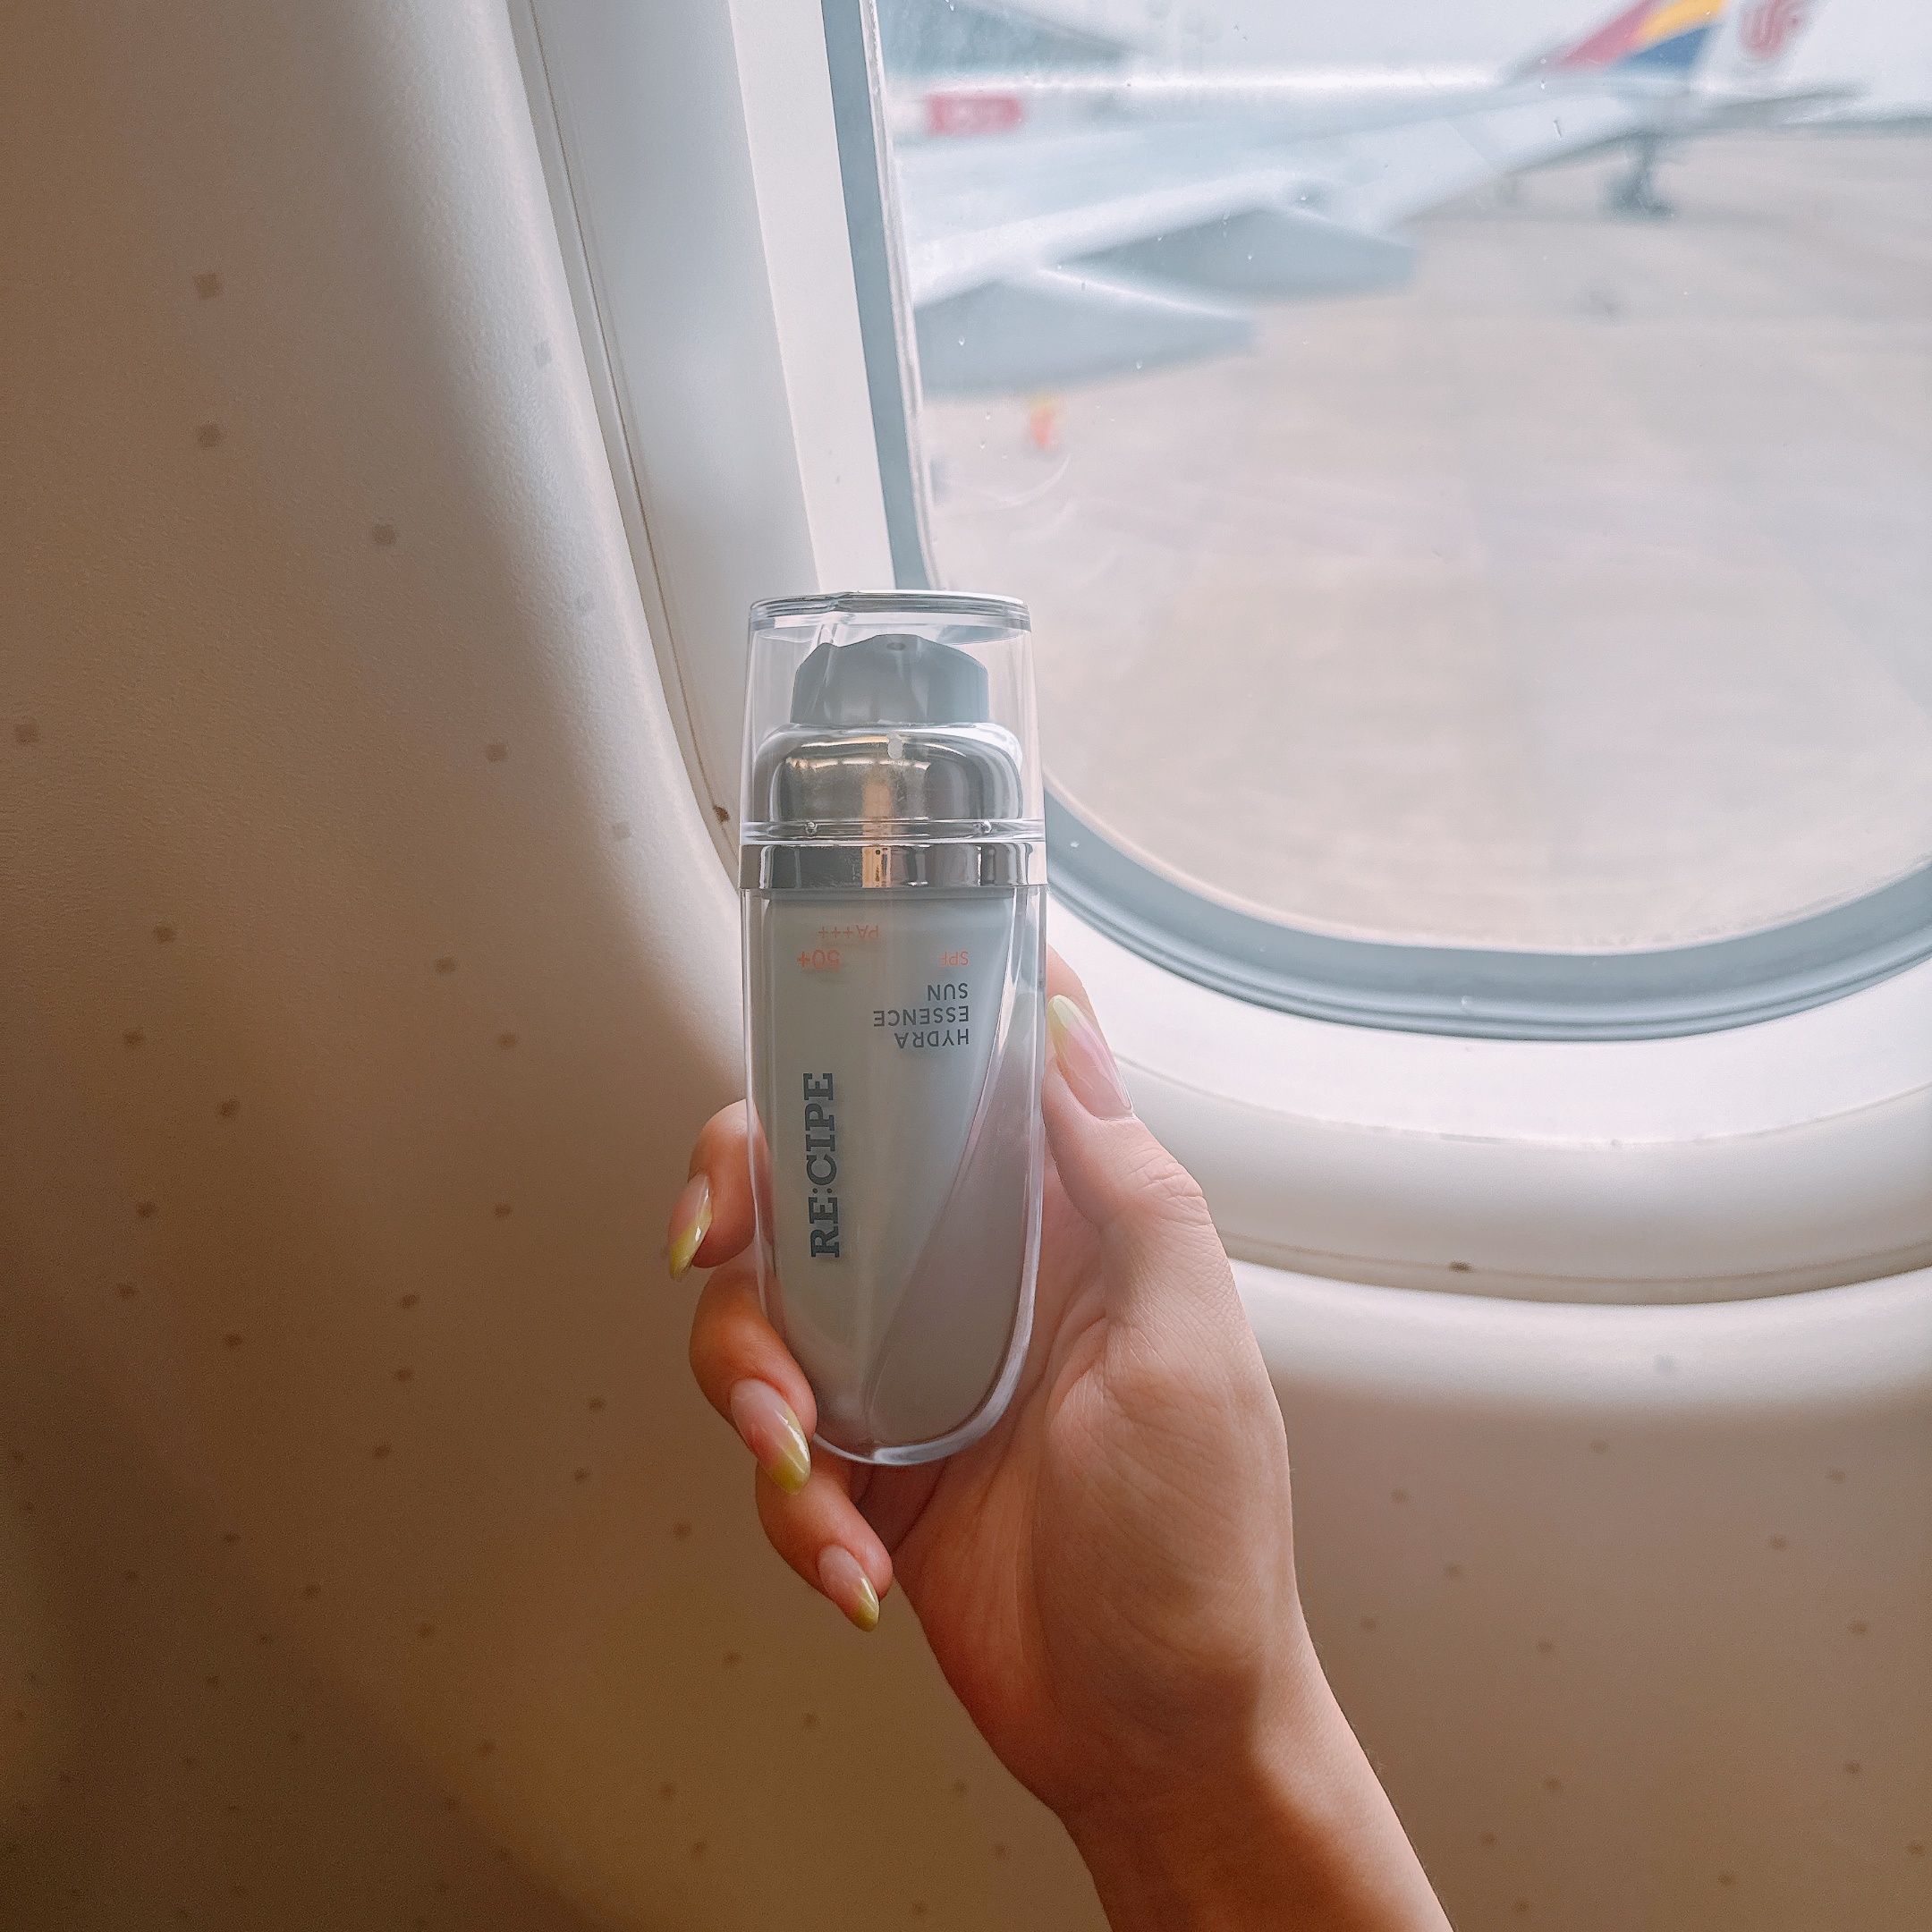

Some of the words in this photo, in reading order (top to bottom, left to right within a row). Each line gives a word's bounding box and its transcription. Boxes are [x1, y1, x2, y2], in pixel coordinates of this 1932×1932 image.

[818, 924, 879, 939] PA+++
[797, 949, 841, 970] 50+
[938, 951, 970, 967] SPF
[927, 982, 969, 1002] SUN
[873, 1005, 970, 1028] ESSENCE
[894, 1028, 970, 1049] HYDRA
[803, 1072, 841, 1258] RE:CIPE
